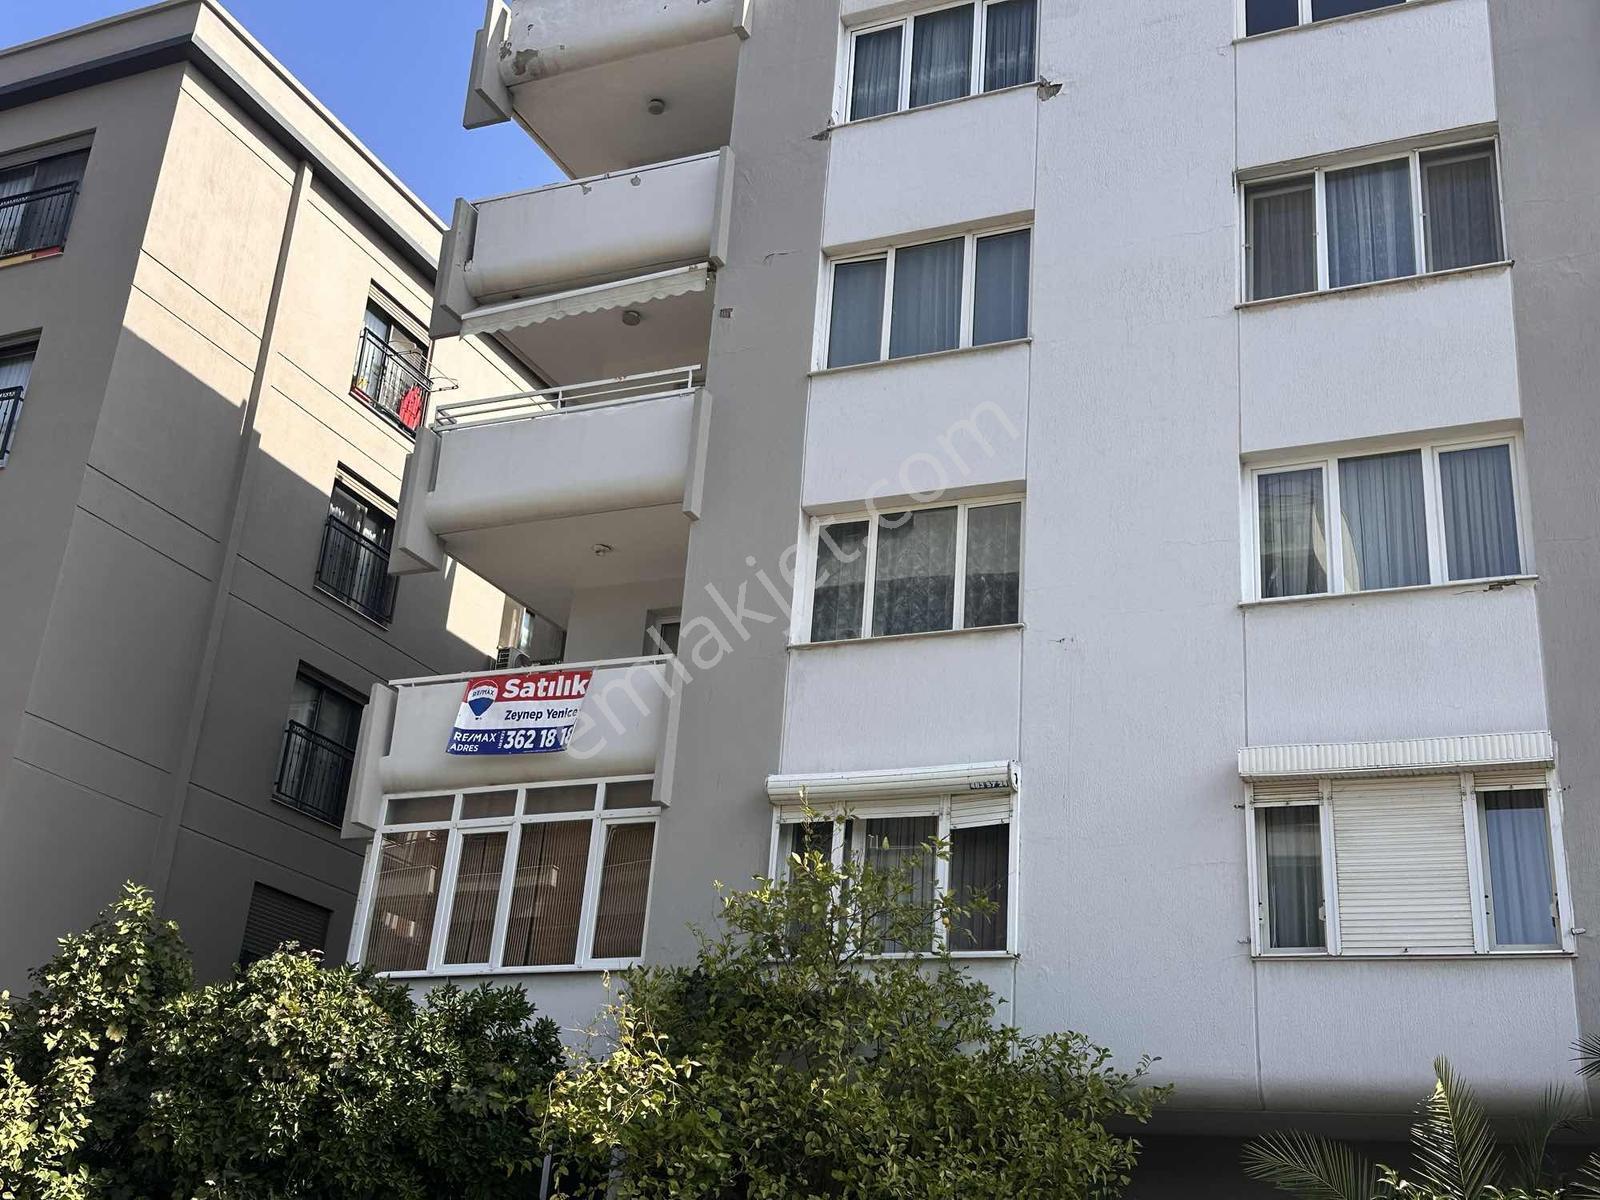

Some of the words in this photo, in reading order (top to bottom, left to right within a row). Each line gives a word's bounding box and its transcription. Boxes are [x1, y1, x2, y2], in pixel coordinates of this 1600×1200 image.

[502, 674, 589, 698] Satılık
[504, 710, 543, 721] Zeynep
[453, 732, 496, 742] RE/MAX
[503, 730, 537, 749] 362
[540, 729, 556, 748] 18
[450, 743, 479, 752] ADRES
